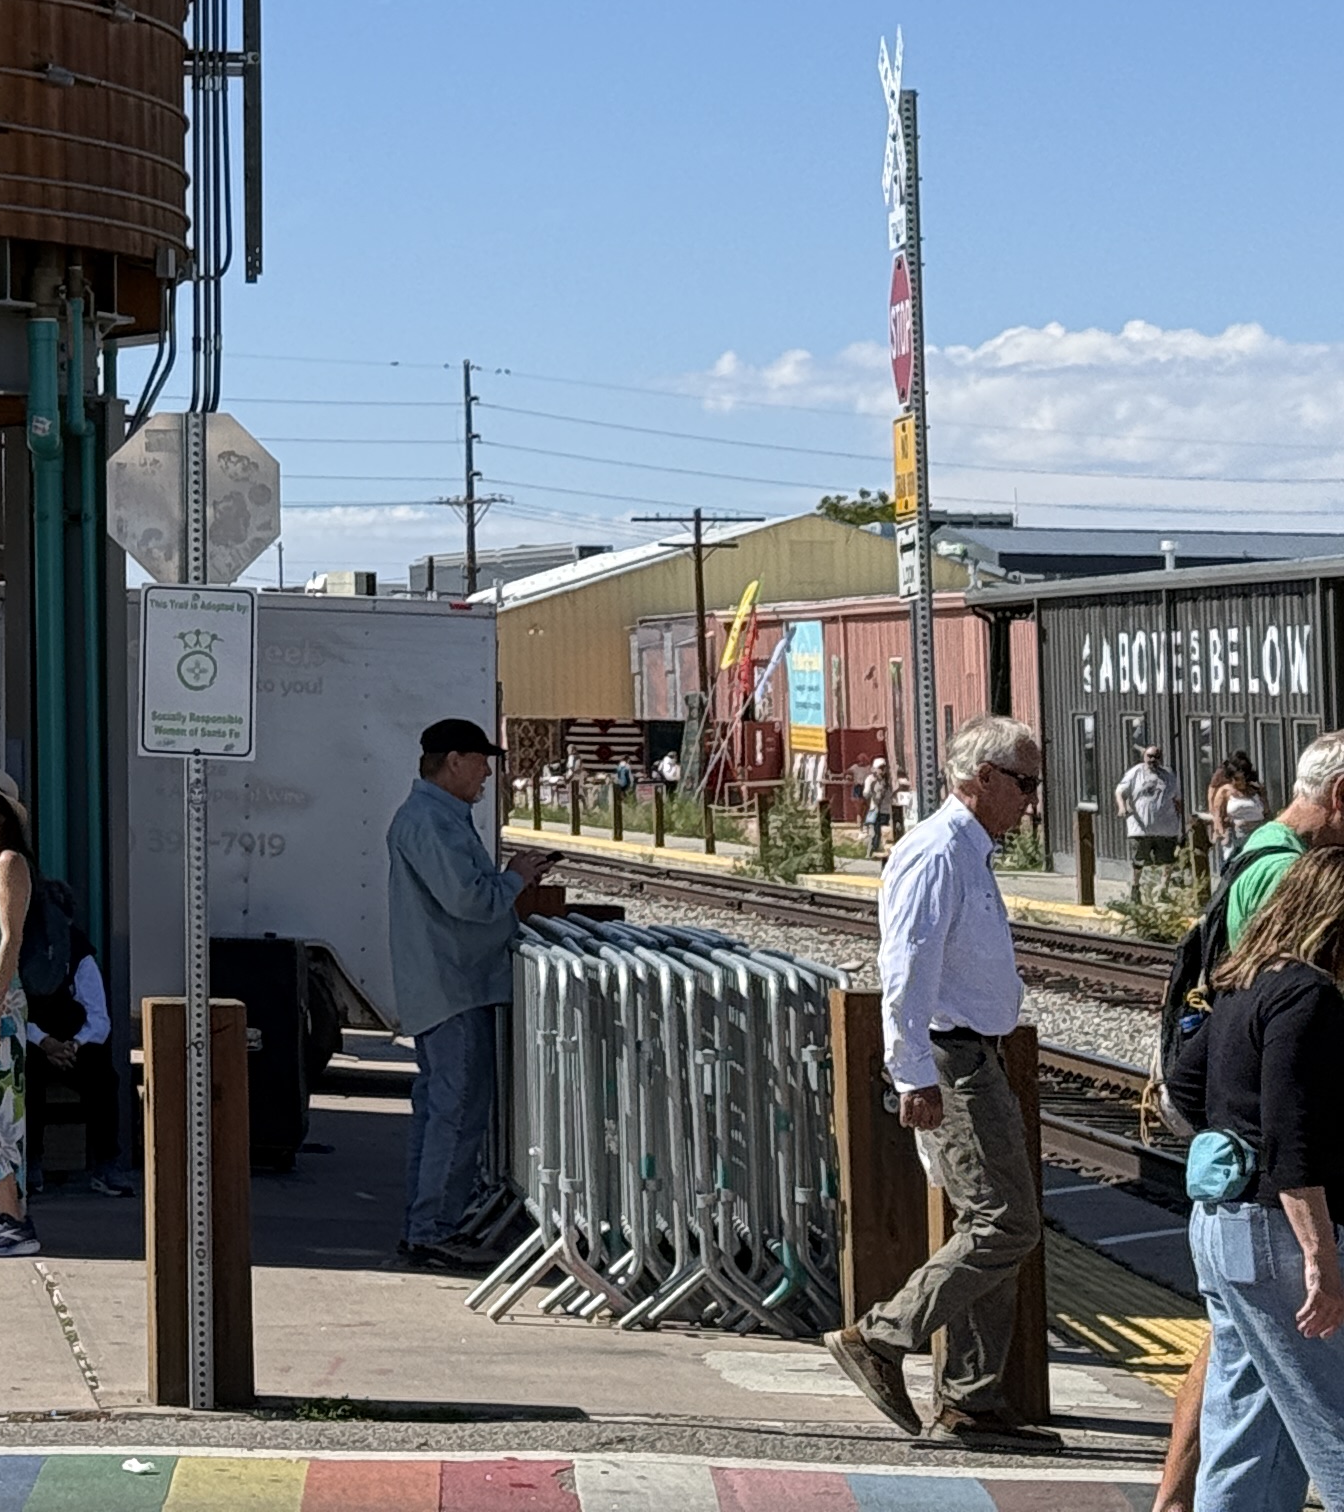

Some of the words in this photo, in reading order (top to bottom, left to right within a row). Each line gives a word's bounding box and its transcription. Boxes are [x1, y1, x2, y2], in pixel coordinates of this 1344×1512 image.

[890, 299, 910, 360] STOP
[150, 598, 168, 610] This
[169, 599, 189, 611] Trail
[200, 600, 235, 613] Adopted
[1099, 630, 1184, 695] ABOVE
[1209, 624, 1311, 696] BELOW
[281, 677, 323, 697] you!
[151, 710, 187, 725] Socially
[188, 711, 244, 726] Responsible
[153, 725, 187, 737] Women
[188, 727, 199, 737] of
[200, 727, 227, 738] Santa
[228, 728, 241, 739] Fe
